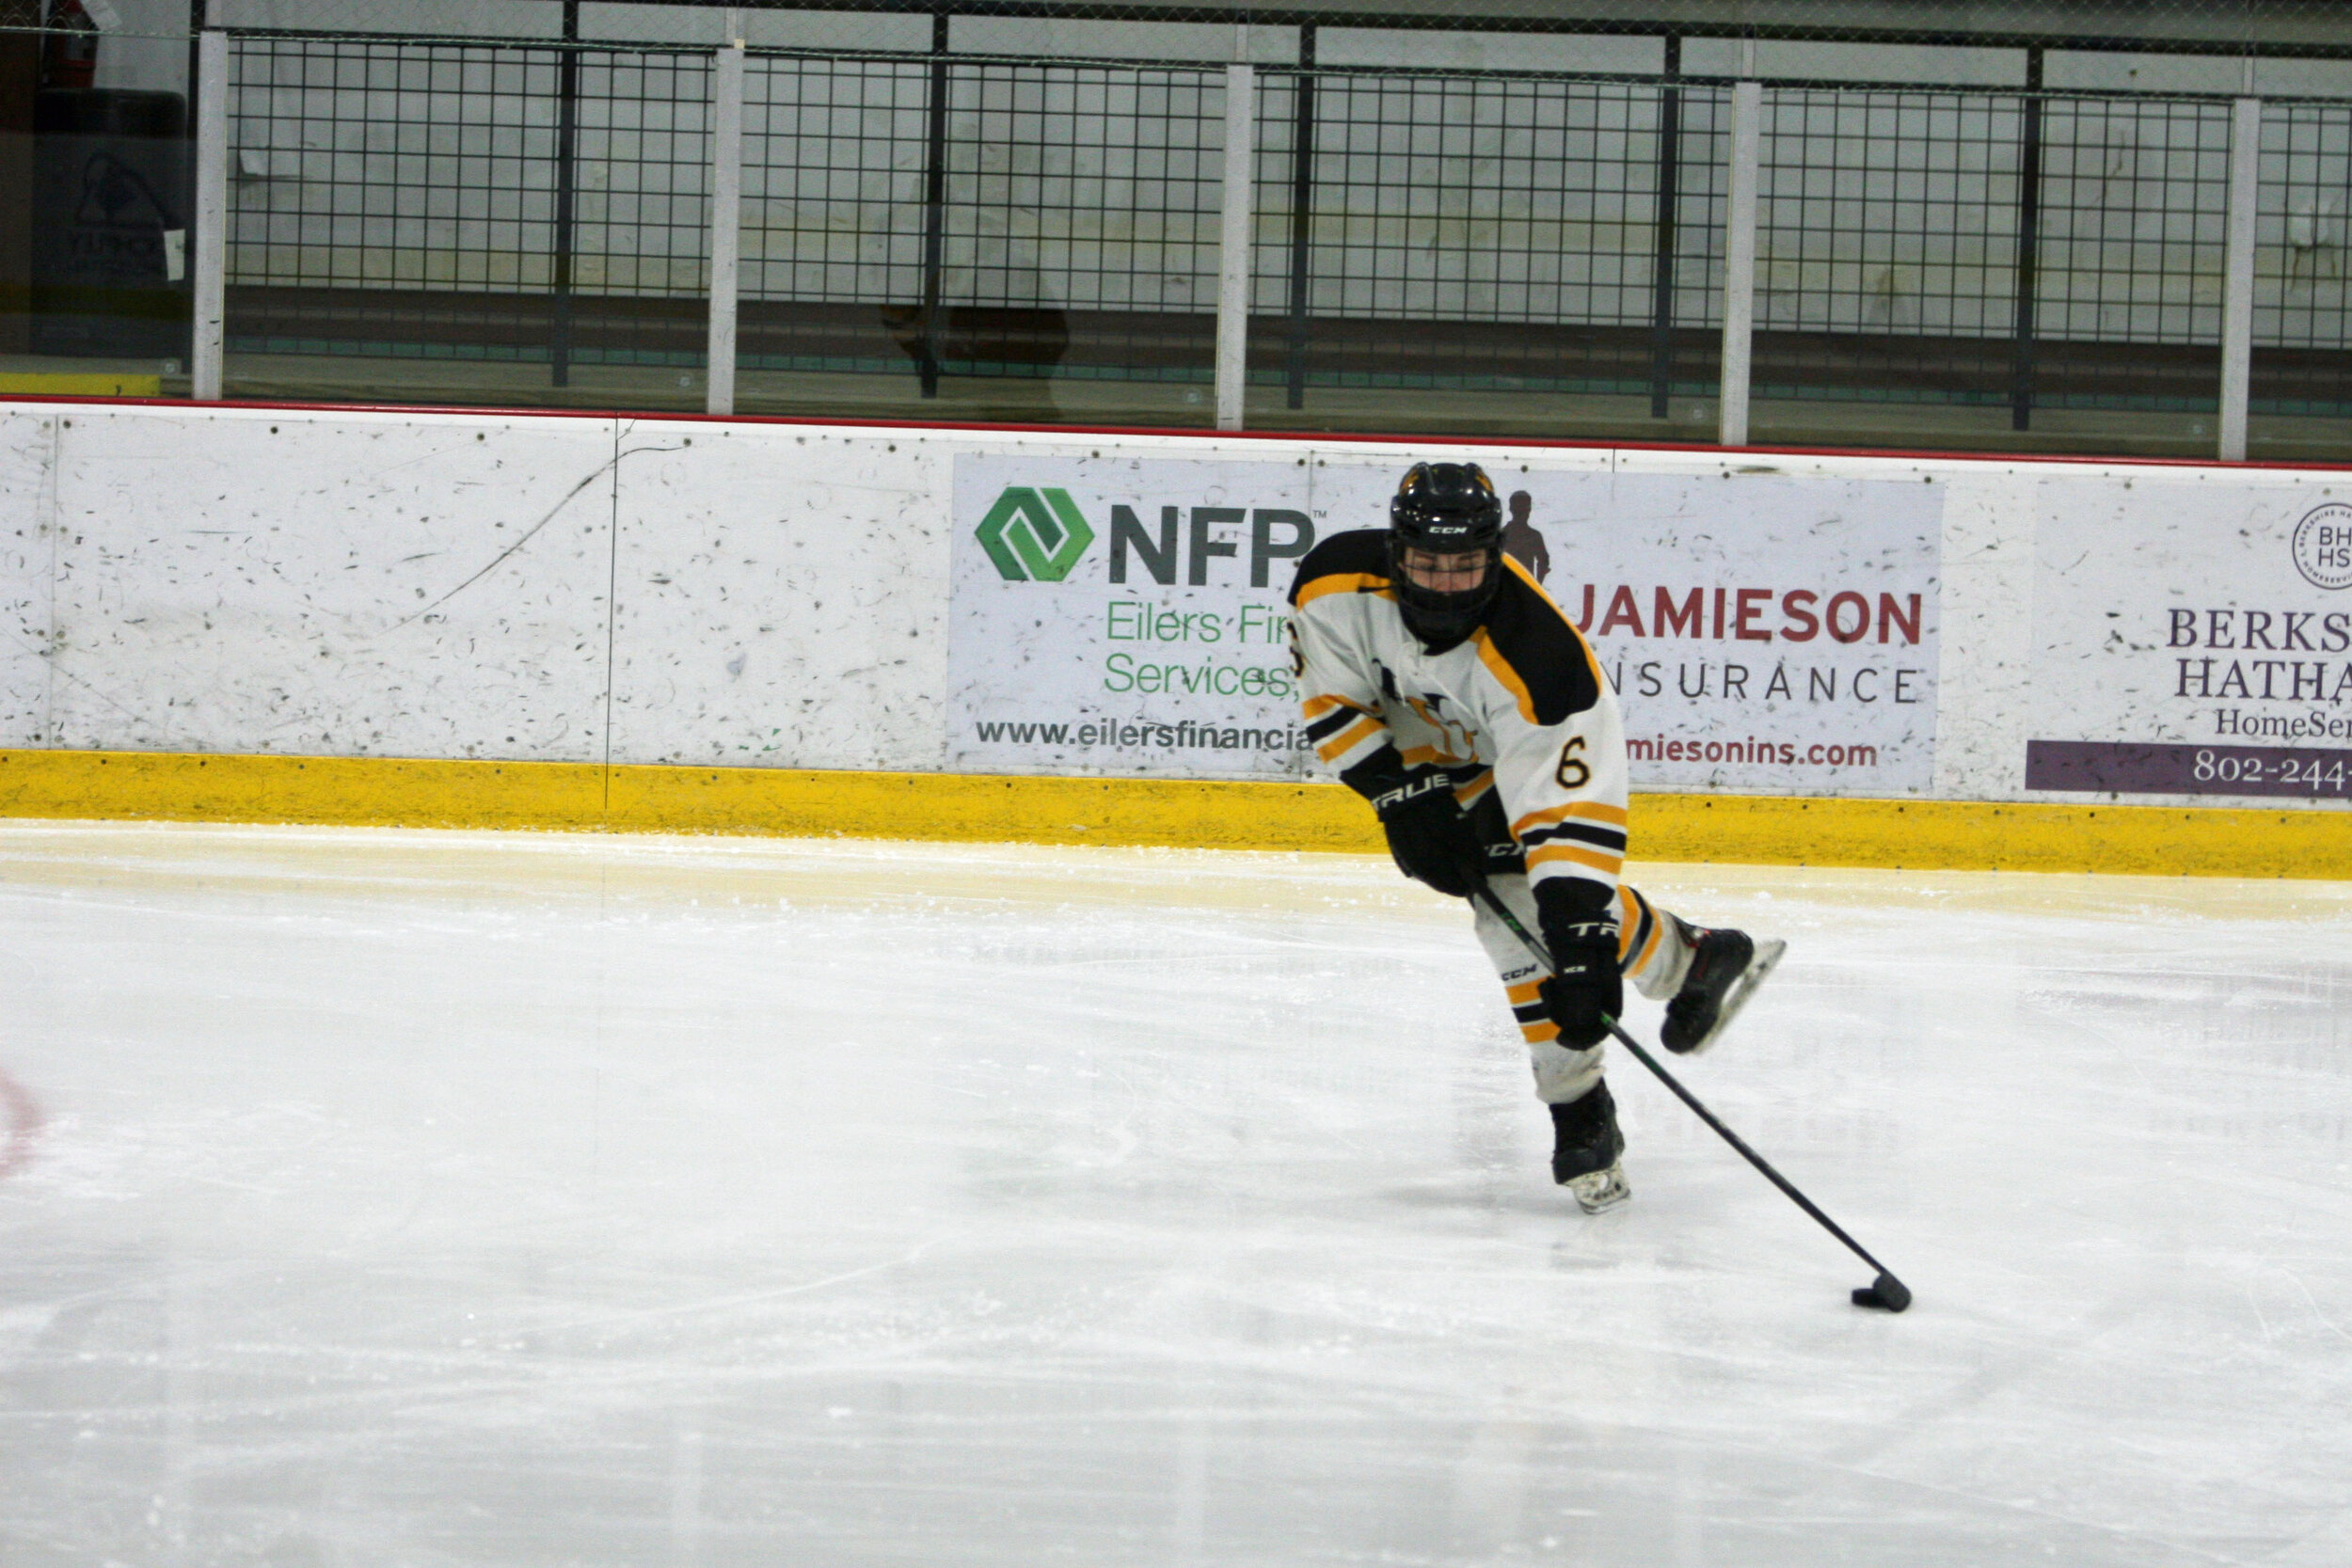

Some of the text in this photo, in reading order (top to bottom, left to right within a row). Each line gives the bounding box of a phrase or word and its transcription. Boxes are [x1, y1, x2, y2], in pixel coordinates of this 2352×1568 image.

[1109, 504, 1315, 588] NFP
[1429, 526, 1468, 534] CCM
[2319, 527, 2352, 546] BH
[2318, 547, 2350, 567] HS
[1107, 601, 1221, 642] Eilers
[1575, 584, 1921, 645] JAMIESON
[2167, 610, 2351, 652] BERKS
[1104, 653, 1299, 703] Services,
[1555, 736, 1590, 789] 6
[1502, 964, 1537, 981] CCM
